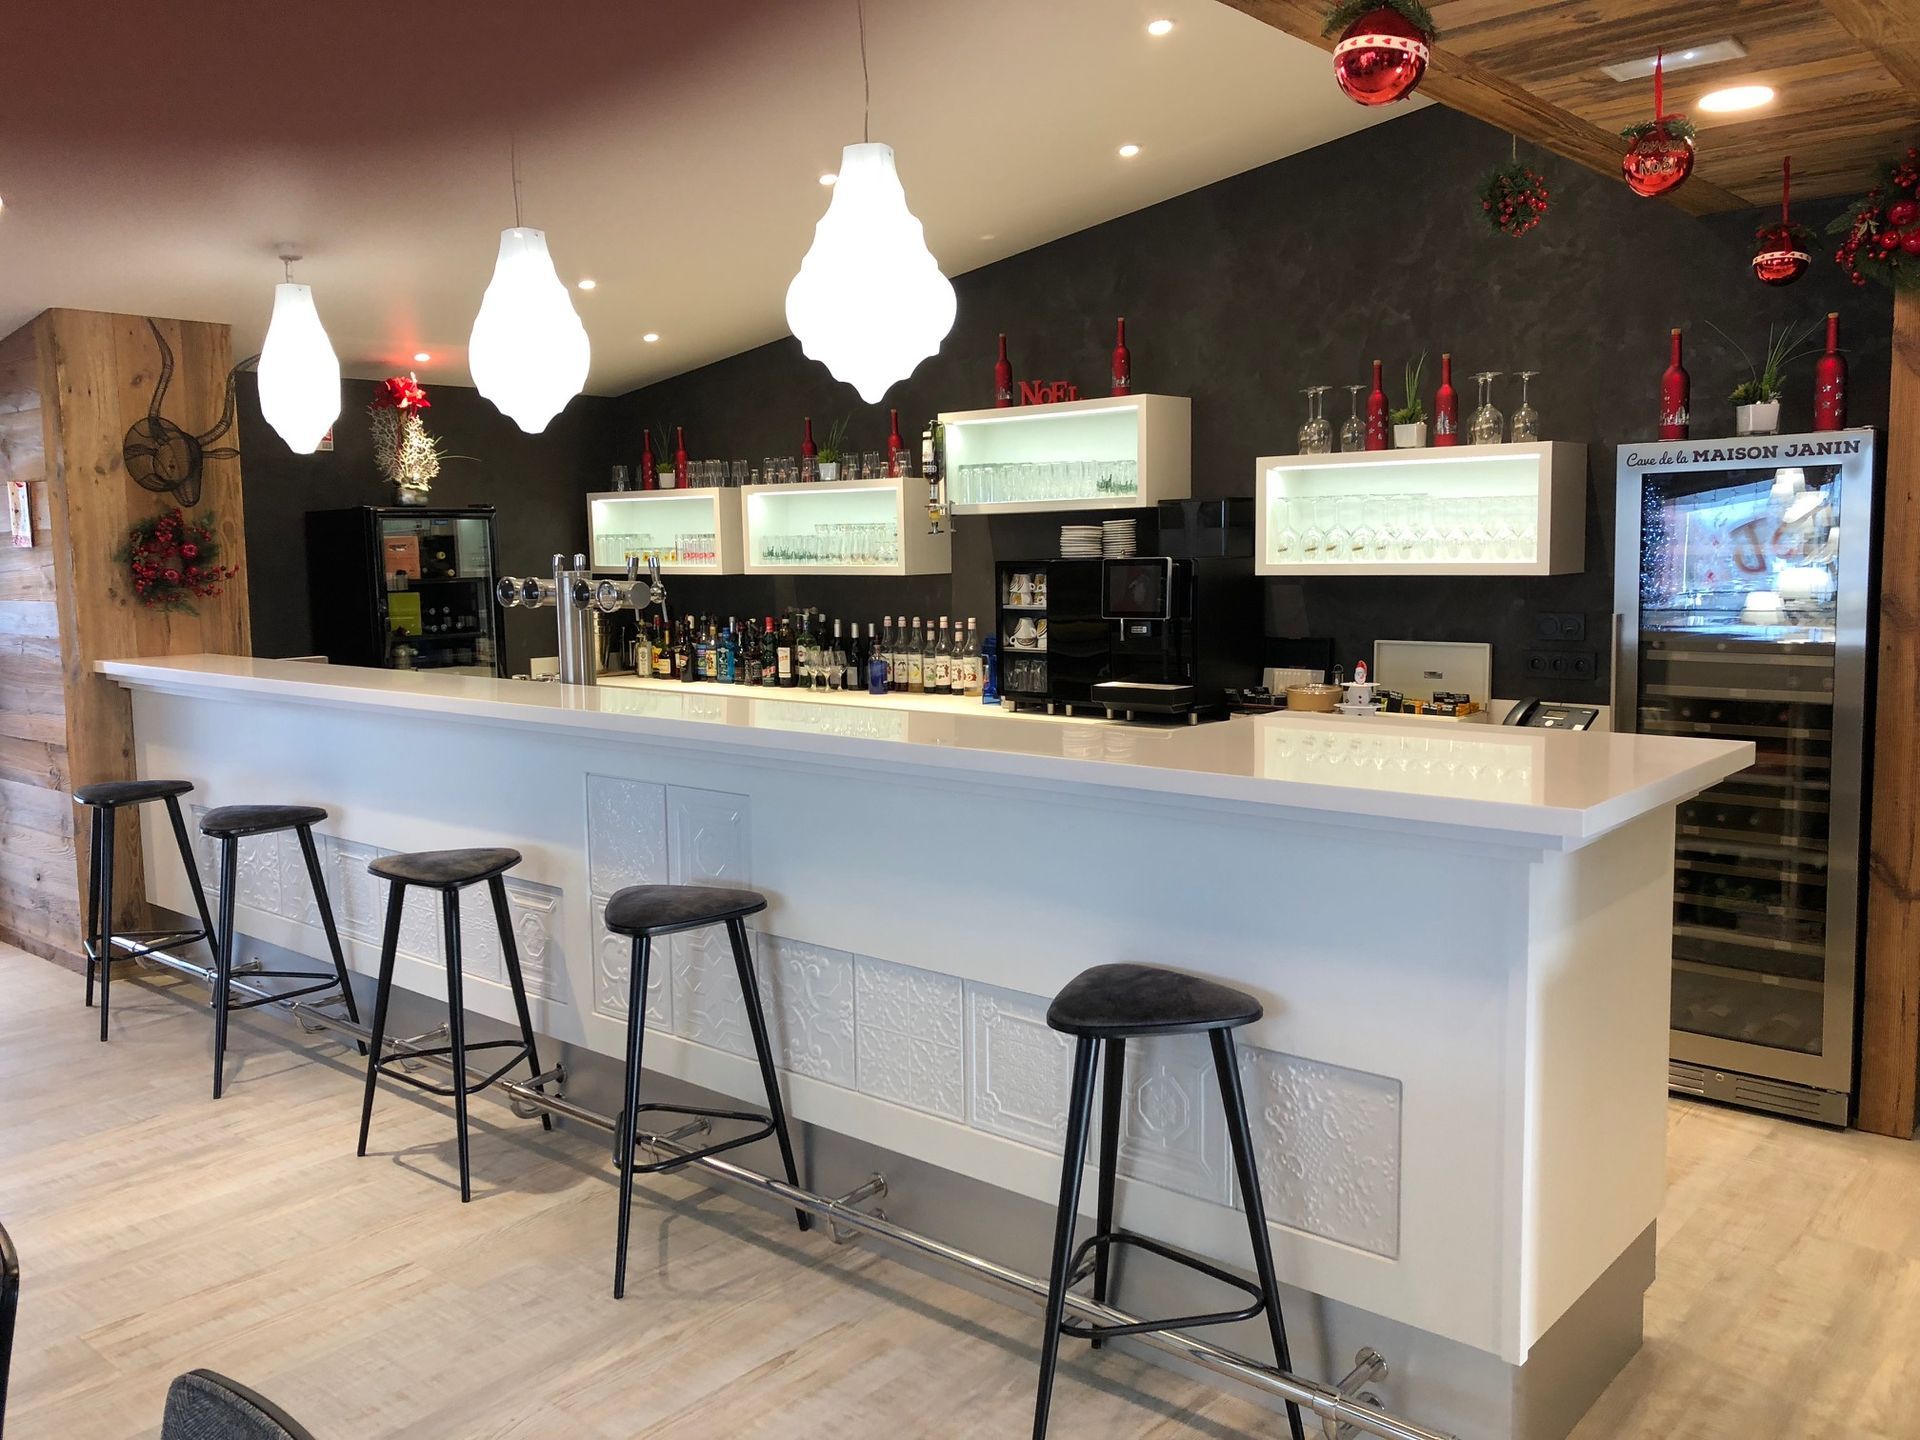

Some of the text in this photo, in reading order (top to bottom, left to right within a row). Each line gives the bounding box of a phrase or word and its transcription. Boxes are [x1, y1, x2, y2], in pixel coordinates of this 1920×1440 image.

[1626, 440, 1861, 467] Cave de la MAISON JANIN
